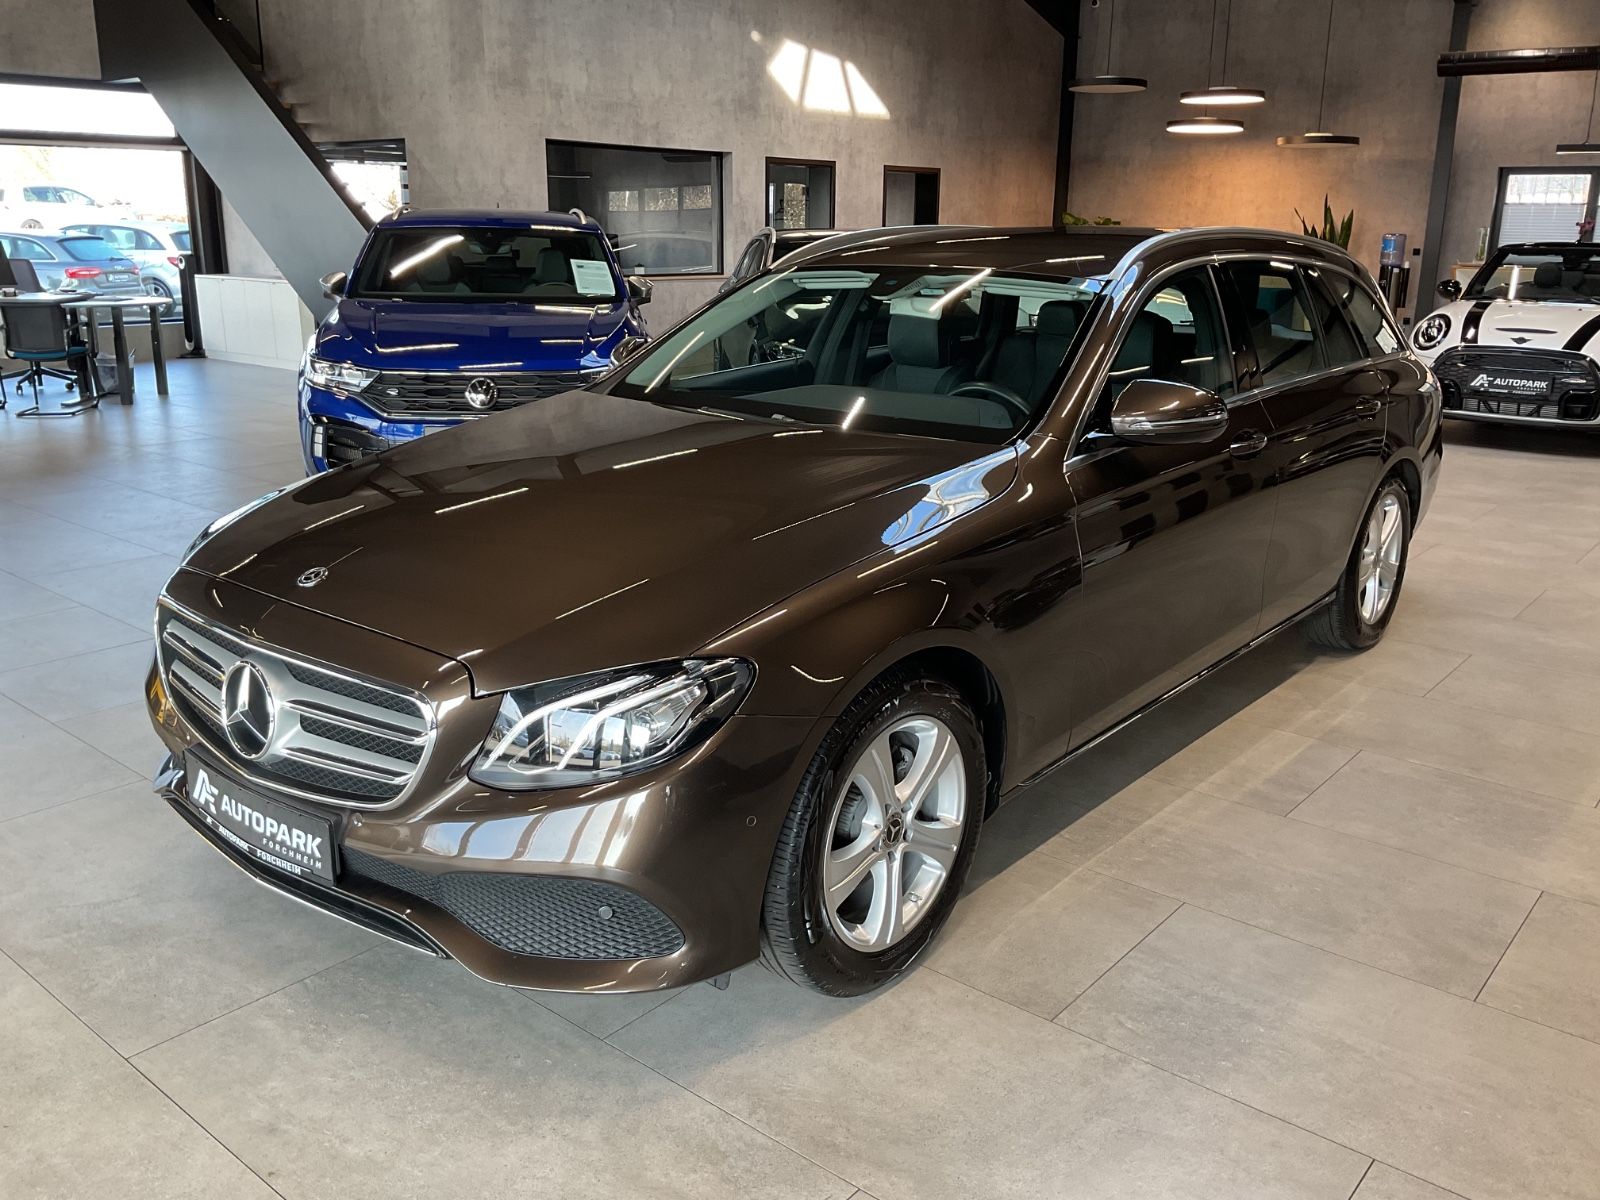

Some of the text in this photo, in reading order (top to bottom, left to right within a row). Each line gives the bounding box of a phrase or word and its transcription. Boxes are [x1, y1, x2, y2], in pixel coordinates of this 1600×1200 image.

[1494, 378, 1549, 389] AUTOPARK
[221, 794, 323, 858] AUTOPARK
[256, 849, 302, 875] FORCHHEIM
[262, 837, 322, 869] FORCHHEIM
